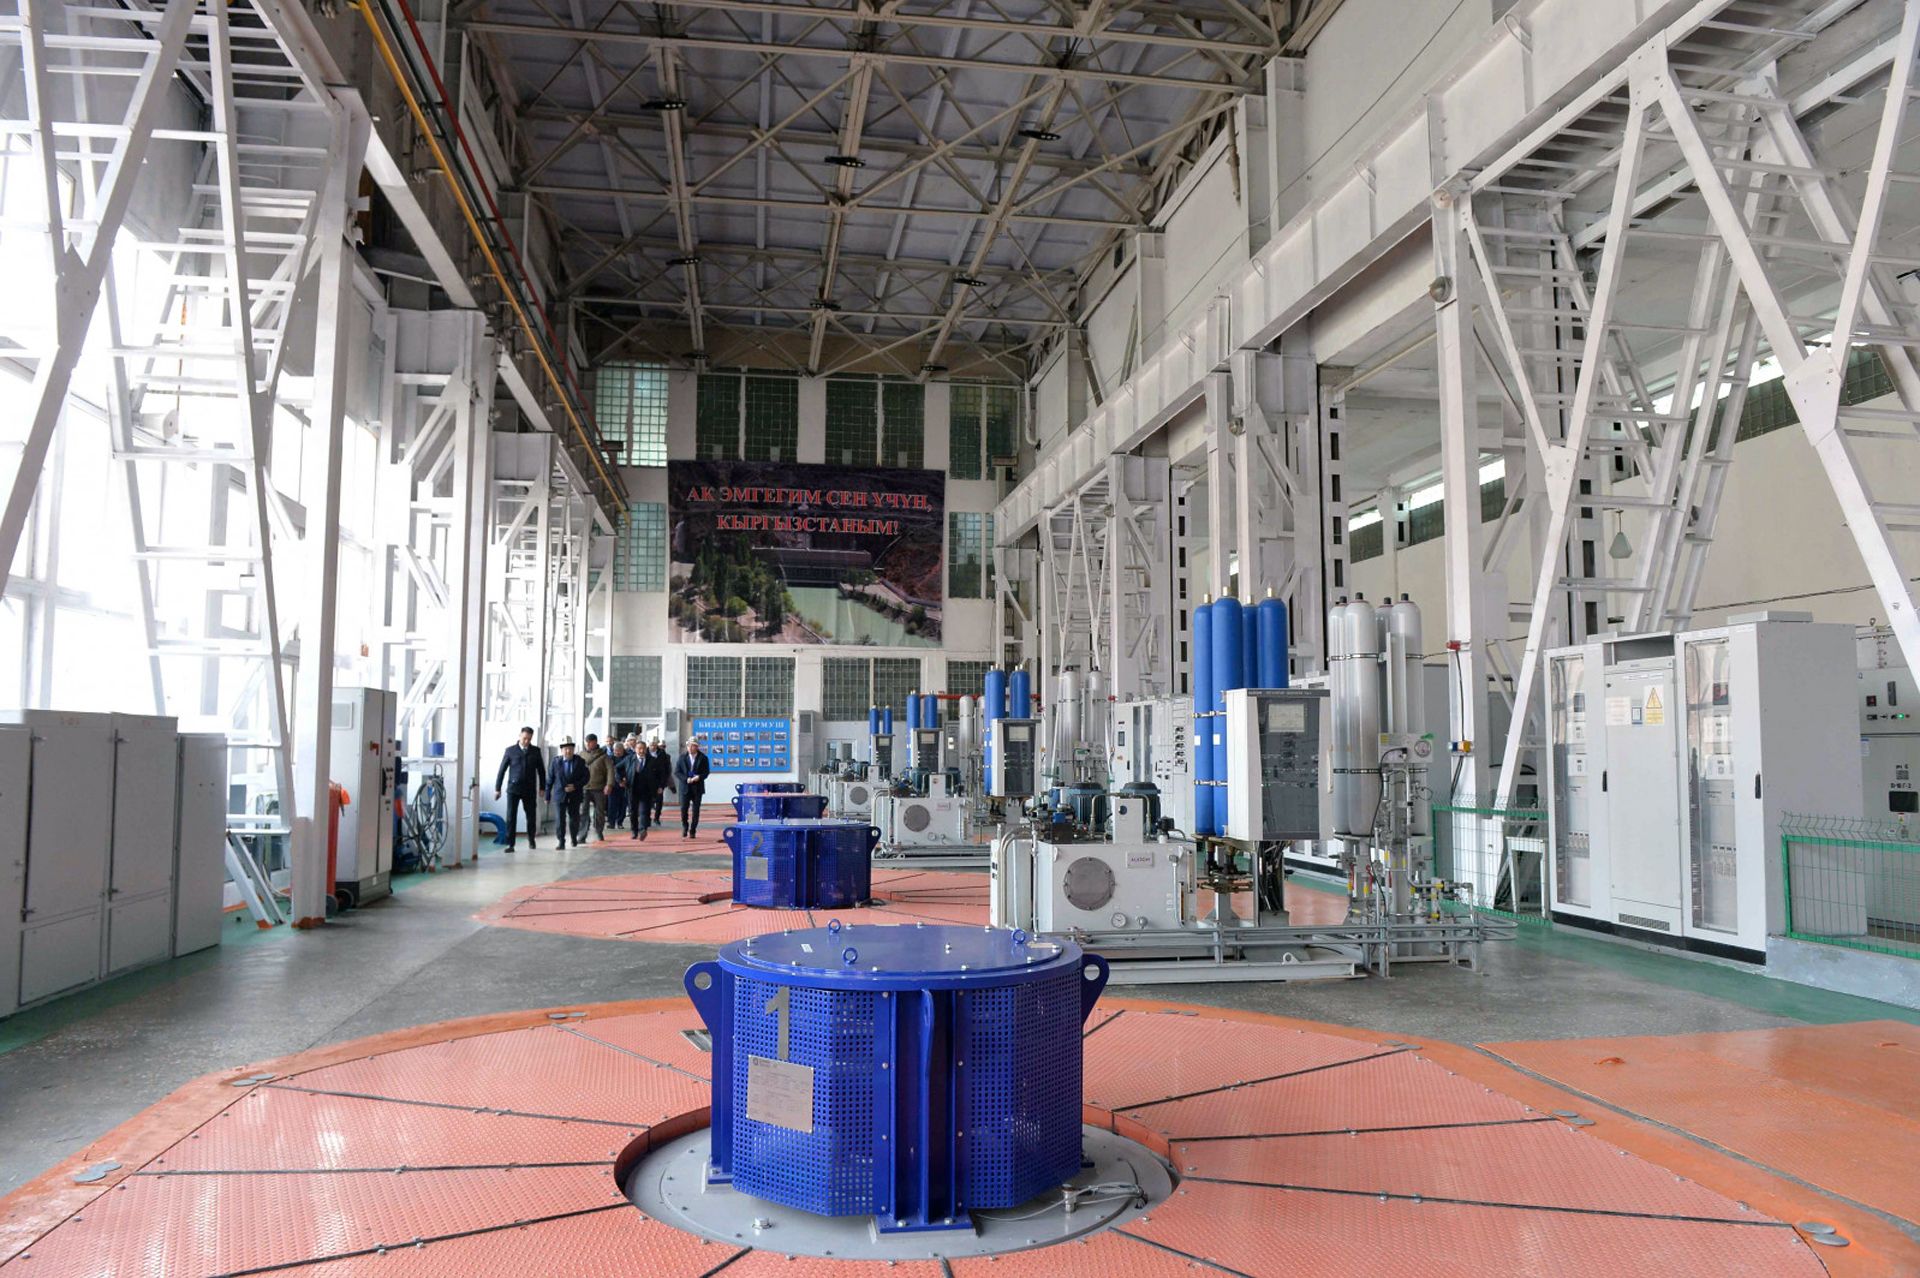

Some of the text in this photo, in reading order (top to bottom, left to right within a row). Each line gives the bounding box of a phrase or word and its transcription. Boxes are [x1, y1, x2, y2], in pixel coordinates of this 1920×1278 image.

[686, 486, 715, 502] АК
[719, 486, 822, 505] ЭМГЕГИМ
[826, 490, 868, 507] СЕН
[716, 514, 899, 536] КЫРГЫЗСТАНЫМ!
[698, 721, 785, 729] БИЗДИН ТУРМУШ
[751, 831, 764, 857] 2
[765, 986, 790, 1060] 1
